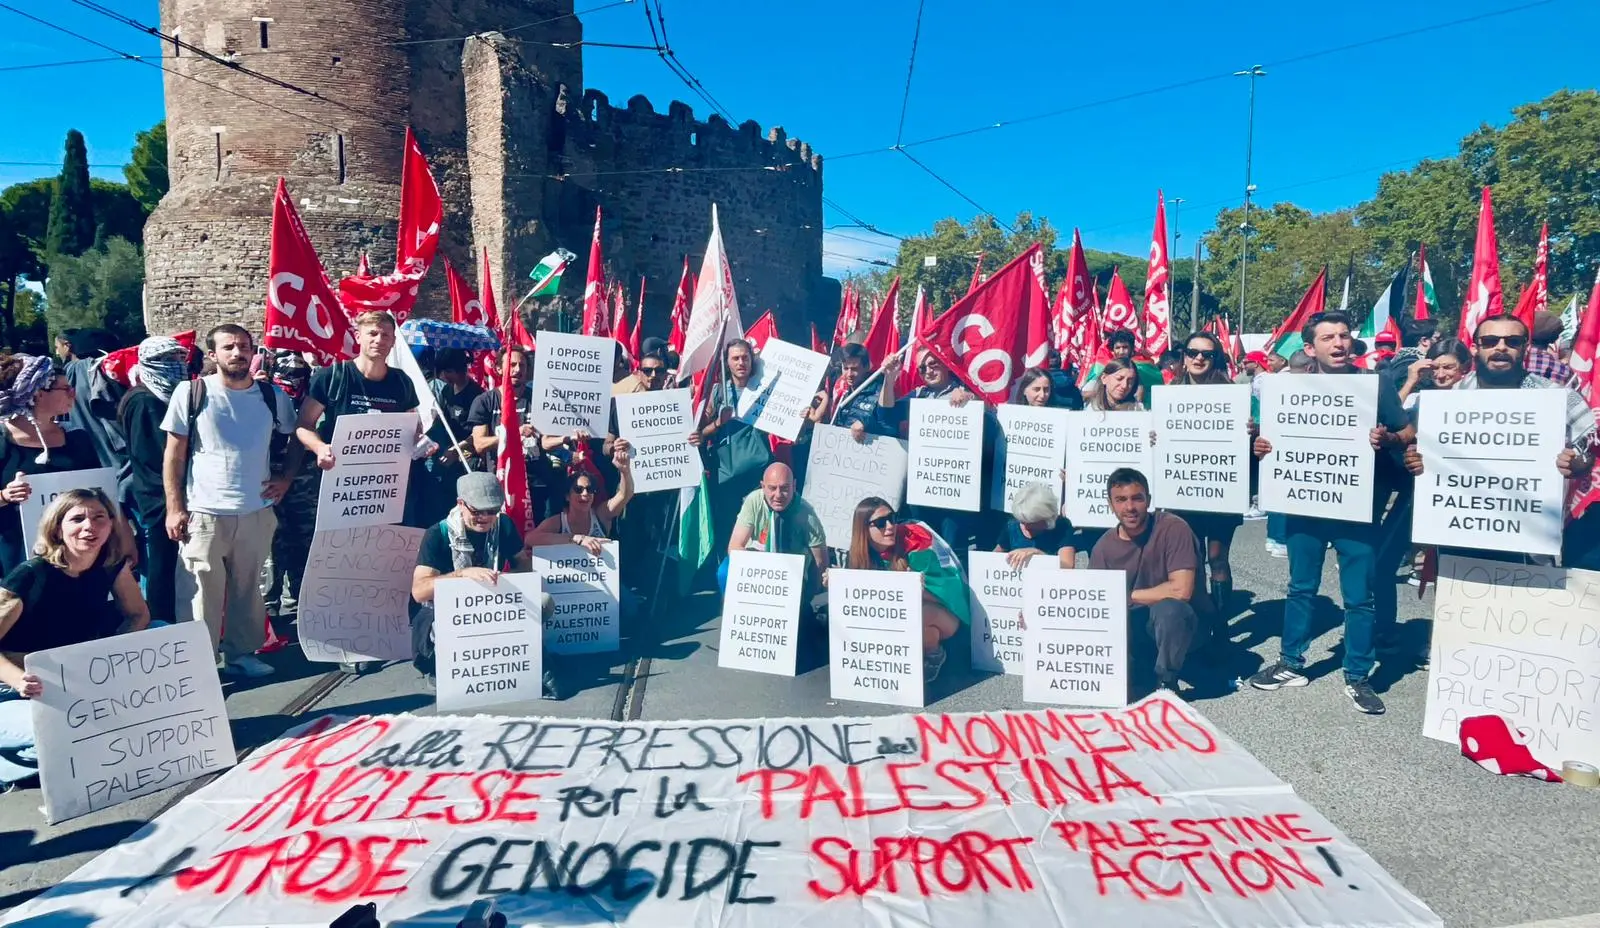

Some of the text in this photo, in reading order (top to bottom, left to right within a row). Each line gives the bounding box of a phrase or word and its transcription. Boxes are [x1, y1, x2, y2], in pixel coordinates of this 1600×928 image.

[550, 348, 600, 360] I OPPOSE
[547, 361, 601, 373] GENOCIDE
[778, 354, 814, 370] OPPOSE
[544, 389, 602, 401] I SUPPORT
[1281, 394, 1354, 408] I OPPOSE
[542, 402, 601, 414] PALESTINE
[639, 403, 679, 415] OPPOSE
[1168, 403, 1231, 414] I OPPOSE
[551, 416, 590, 426] ACTION
[632, 416, 683, 428] GENOCIDE
[922, 415, 968, 426] I OPPOSE
[1166, 419, 1234, 431] GENOCIDE
[1277, 413, 1358, 427] GENOCIDE
[1444, 412, 1536, 425] I OPPOSE
[920, 428, 970, 440] GENOCIDE
[1014, 421, 1053, 434] OPPOSE
[1083, 428, 1139, 438] I OPPOSE
[348, 429, 401, 440] I OPPOSE
[1006, 434, 1054, 448] GENOCIDE
[1438, 432, 1540, 446] GENOCIDE
[342, 443, 402, 455] GENOCIDE
[641, 443, 687, 455] SUPPORT
[1080, 443, 1142, 452] GENOCIDE
[634, 456, 690, 469] PALESTINE
[811, 452, 888, 476] GENOCIDE
[918, 458, 970, 470] I SUPPORT
[1166, 453, 1236, 466] I SUPPORT
[1276, 451, 1359, 467] I SUPPORT
[646, 469, 681, 480] ACTION
[916, 471, 970, 484] PALESTINE
[1008, 464, 1053, 479] SUPPORT
[1164, 470, 1237, 483] PALESTINE
[1274, 469, 1359, 486] PALESTINE
[336, 474, 398, 486] I SUPPORT
[1080, 474, 1082, 483] I
[1436, 474, 1542, 492] I SUPPORT
[332, 488, 398, 502] PALESTINE
[925, 486, 961, 498] ACTION
[1176, 487, 1224, 498] ACTION
[1287, 488, 1342, 504] ACTION
[41, 494, 45, 506] I
[1432, 495, 1542, 513] PALESTINE
[342, 504, 385, 517] ACTION
[1449, 516, 1520, 534] ACTION
[550, 557, 604, 569] I OPPOSE
[547, 572, 606, 585] GENOCIDE
[741, 568, 788, 580] I OPPOSE
[986, 569, 988, 579] I
[737, 583, 788, 596] GENOCIDE
[1450, 560, 1600, 611] I OPPOSE
[316, 585, 408, 608] SUPPORT
[455, 592, 522, 608] I OPPOSE
[845, 588, 904, 602] I OPPOSE
[1041, 589, 1106, 601] I OPPOSE
[554, 602, 608, 616] SUPPORT
[842, 606, 907, 620] GENOCIDE
[1038, 606, 1110, 619] GENOCIDE
[303, 610, 406, 635] PALESTINE
[452, 609, 526, 625] GENOCIDE
[546, 616, 610, 629] PALESTINE
[734, 615, 788, 629] I SUPPORT
[985, 618, 987, 627] I
[557, 631, 599, 642] ACTION
[731, 630, 787, 645] PALESTINE
[983, 633, 1022, 646] PALES
[453, 644, 529, 662] I SUPPORT
[738, 648, 776, 660] ACTION
[843, 641, 909, 656] I SUPPORT
[1038, 643, 1112, 657] I SUPPORT
[842, 658, 911, 674] PALESTINE
[1438, 645, 1442, 674] I
[60, 640, 190, 693] I OPPOSE
[451, 661, 530, 679] PALESTINE
[1037, 661, 1114, 675] PALESTINE
[466, 679, 517, 694] ACTION
[854, 676, 898, 690] ACTION
[1050, 679, 1100, 692] ACTION
[66, 677, 196, 729] GENOCIDE
[1437, 677, 1592, 731] PALESTINE
[249, 715, 391, 771] NO
[360, 729, 465, 768] alla
[478, 721, 886, 771] REPRESSIONE
[913, 697, 1218, 762] MOVIMENTO
[70, 716, 219, 779] I SUPPORT
[85, 748, 217, 812] PALESTINE
[226, 768, 565, 832] INGLESE
[737, 752, 1165, 818] PALESTINA
[1050, 813, 1333, 850] PALESTINE
[431, 834, 783, 904] GENOCIDE
[807, 829, 1036, 899] SUPPORT
